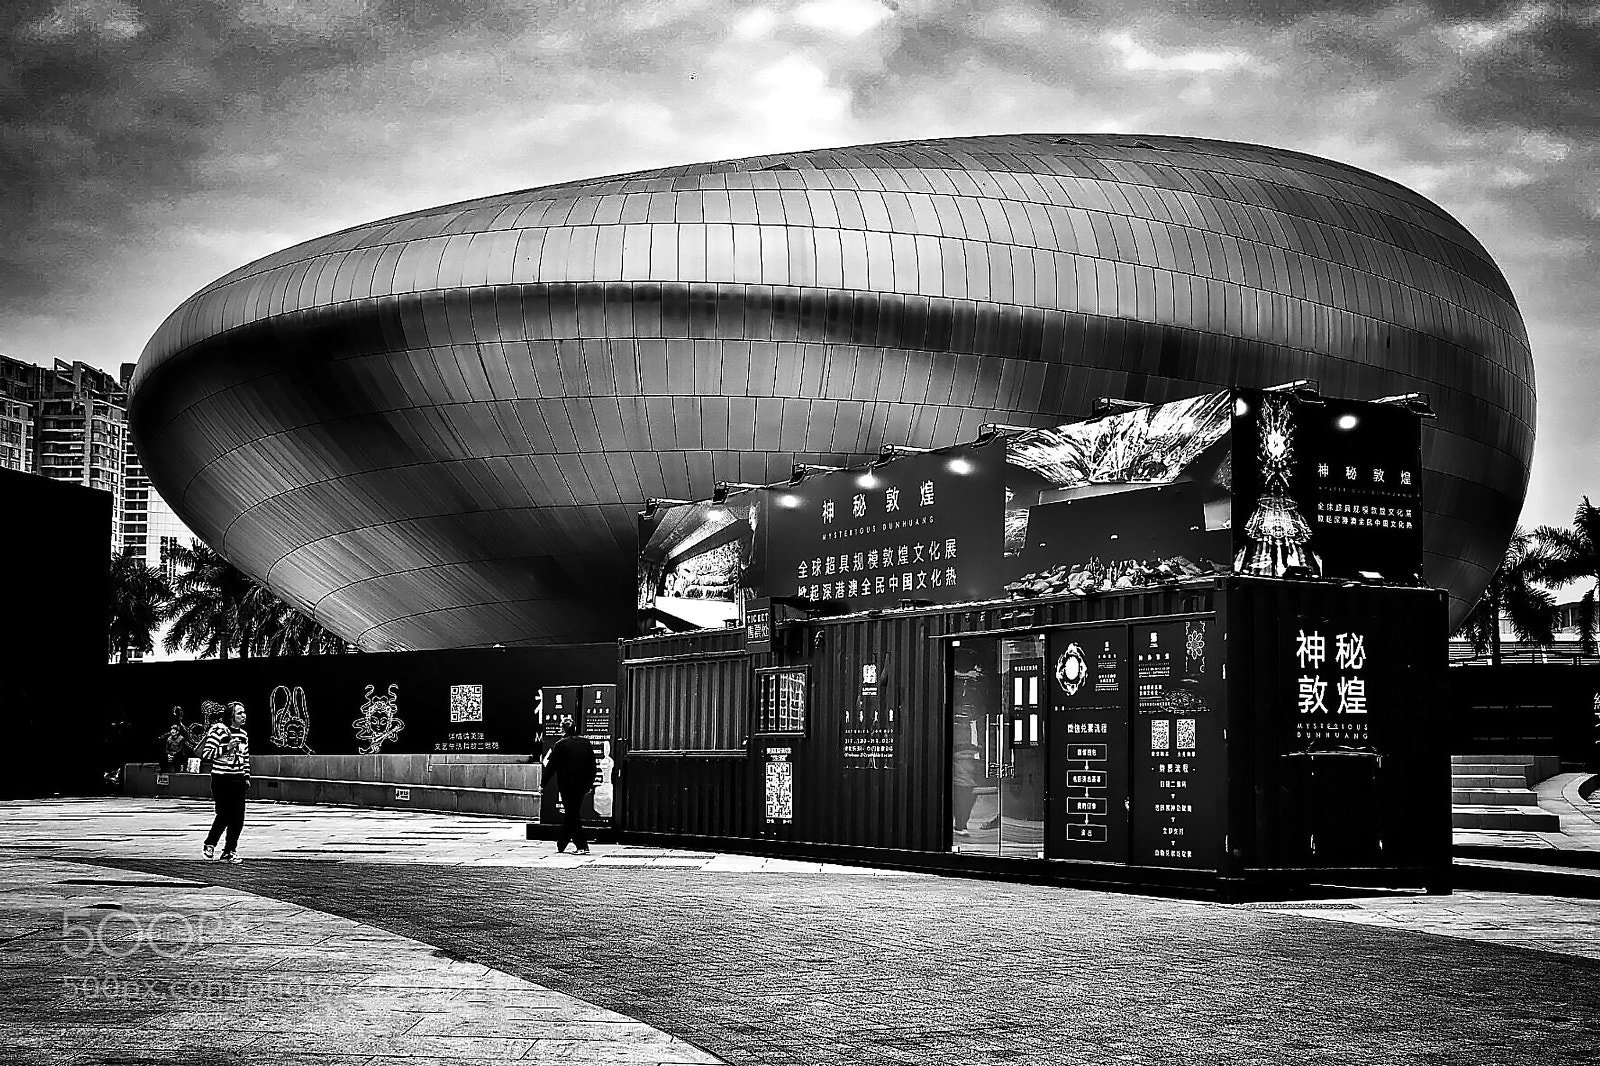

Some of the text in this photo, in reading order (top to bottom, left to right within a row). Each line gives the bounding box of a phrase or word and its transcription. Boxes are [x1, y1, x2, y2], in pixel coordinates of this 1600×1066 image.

[1317, 462, 1412, 485] 神秘敦煌
[821, 479, 935, 525] 神秘敦煌
[822, 515, 934, 541] MYSTERIOUS DUNHUANG
[797, 538, 957, 579] 全球超具规模敦煌文化展
[746, 612, 769, 624] TICKET
[747, 623, 770, 639] 售票处
[1296, 629, 1367, 670] 神秘
[1298, 674, 1368, 714] 敦煌
[1297, 731, 1368, 740] DUNHUANG
